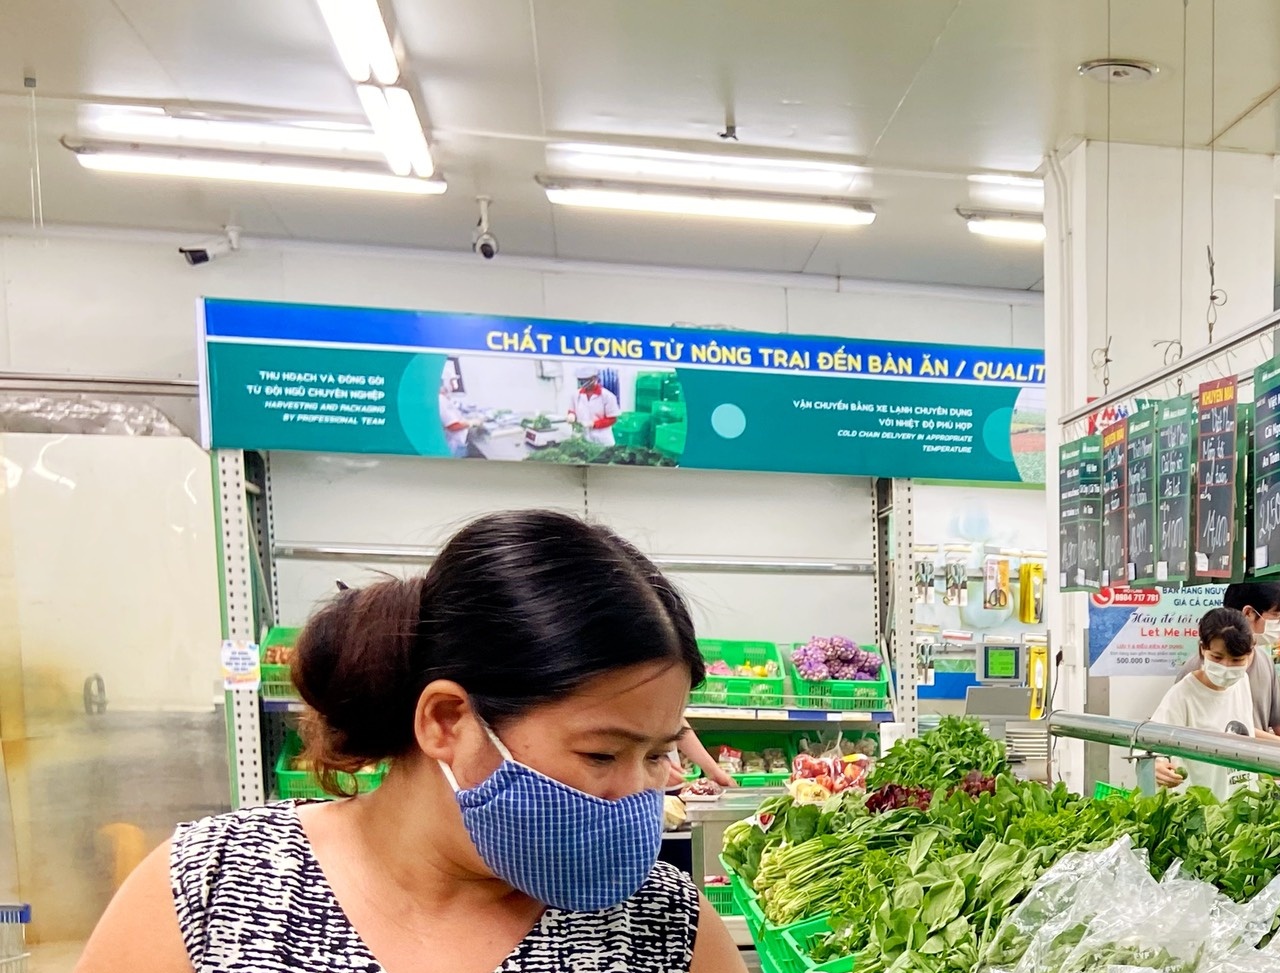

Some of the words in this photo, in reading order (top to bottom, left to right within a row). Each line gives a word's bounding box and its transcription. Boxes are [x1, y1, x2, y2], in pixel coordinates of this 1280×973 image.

[487, 325, 552, 353] CHẤT
[560, 336, 643, 359] LƯỢNG
[691, 340, 751, 365] NÔNG
[759, 348, 809, 372] TRẠI
[817, 345, 862, 372] ĐẾN
[868, 352, 912, 375] BÀN
[919, 354, 948, 376] ĂN
[876, 404, 888, 413] XE
[362, 416, 386, 425] TEAM
[838, 429, 857, 437] COLD
[859, 430, 880, 438] CHAIN
[881, 431, 916, 440] DELIVERY
[925, 434, 973, 442] APPROPRIATE
[922, 445, 972, 453] TEMPERATURE
[1133, 593, 1145, 602] 717
[1140, 628, 1160, 637] Let
[1163, 628, 1180, 637] Me
